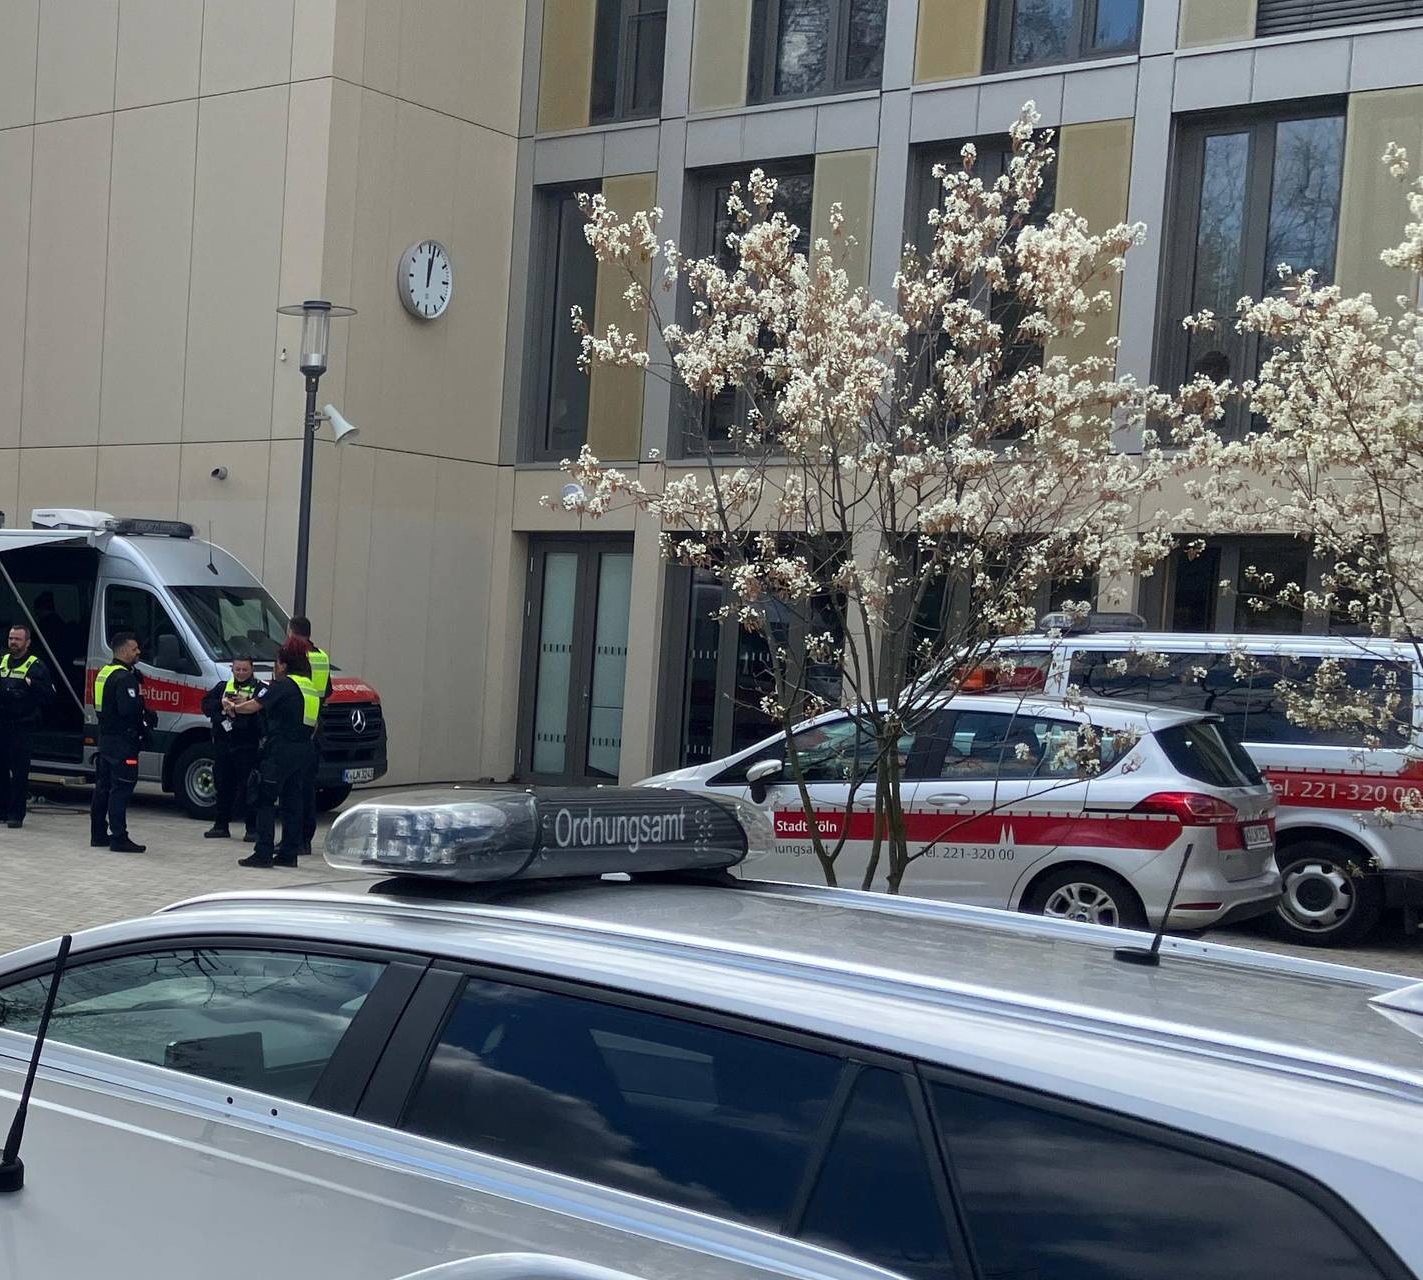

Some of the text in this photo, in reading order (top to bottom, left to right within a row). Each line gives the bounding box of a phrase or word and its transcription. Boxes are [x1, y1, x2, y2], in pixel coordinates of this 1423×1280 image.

[1300, 781, 1387, 802] 221-320
[555, 806, 686, 853] Ordnungsamt
[776, 820, 837, 833] Stadt öln
[943, 846, 995, 861] 221-320
[998, 848, 1015, 861] 00
